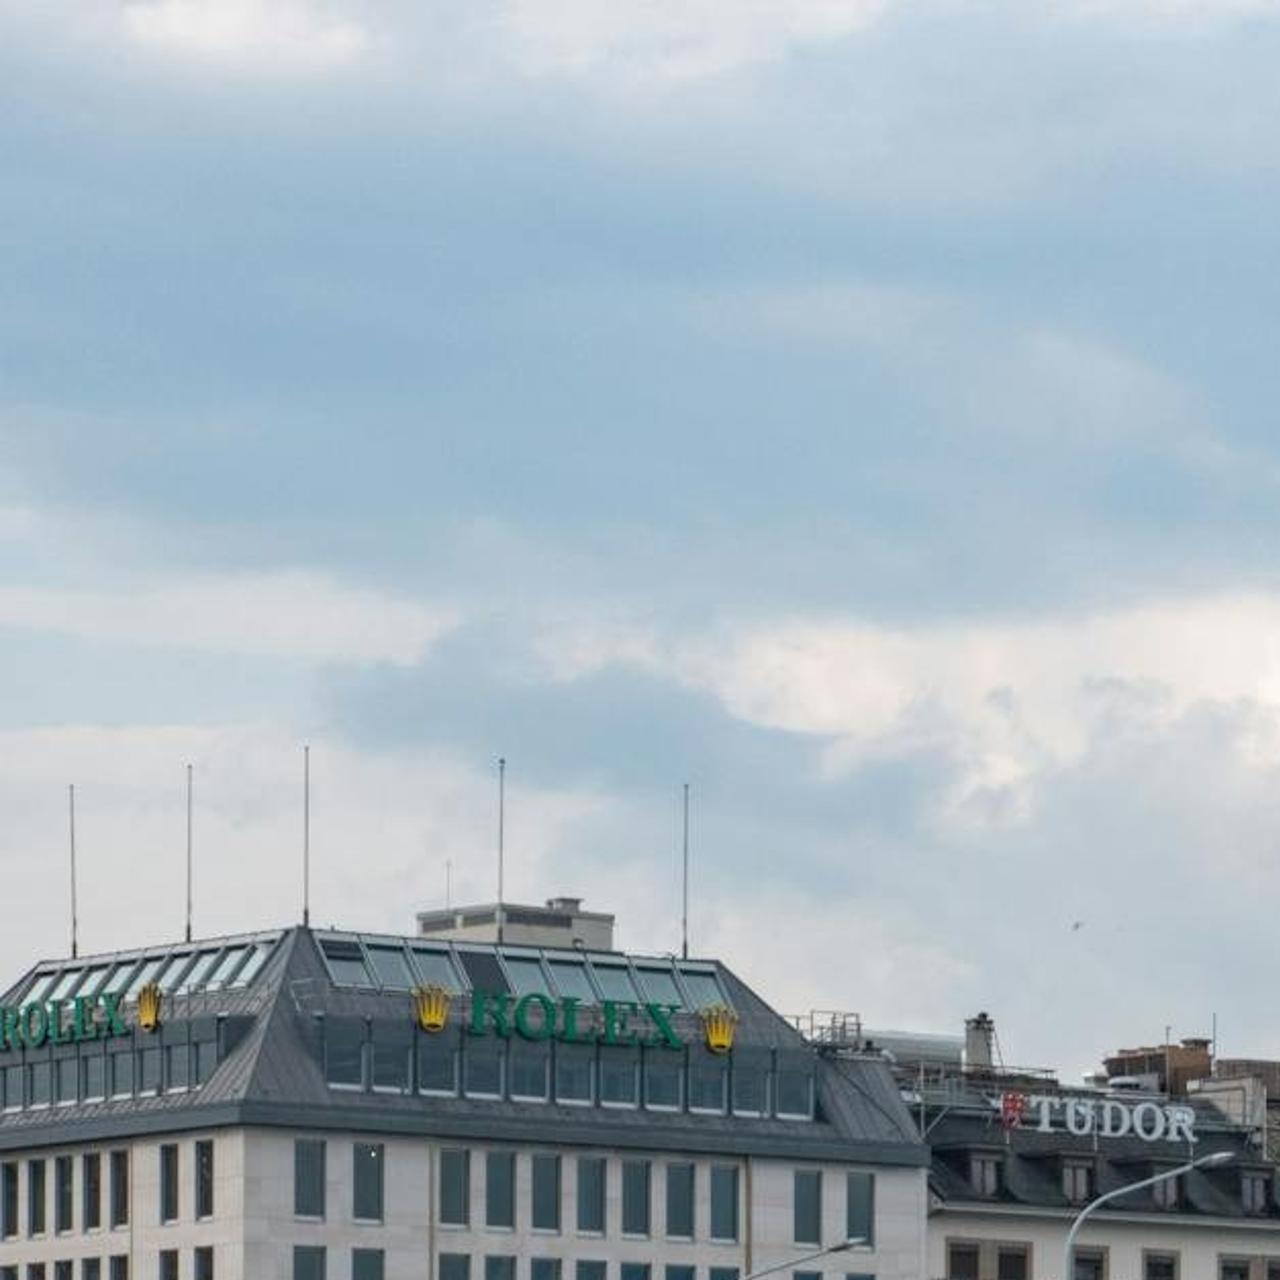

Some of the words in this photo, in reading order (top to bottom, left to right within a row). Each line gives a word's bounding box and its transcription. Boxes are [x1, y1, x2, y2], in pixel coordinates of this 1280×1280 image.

[0, 991, 130, 1050] ROLEX
[466, 988, 686, 1050] ROLEX
[1029, 1095, 1198, 1142] TUDOR
